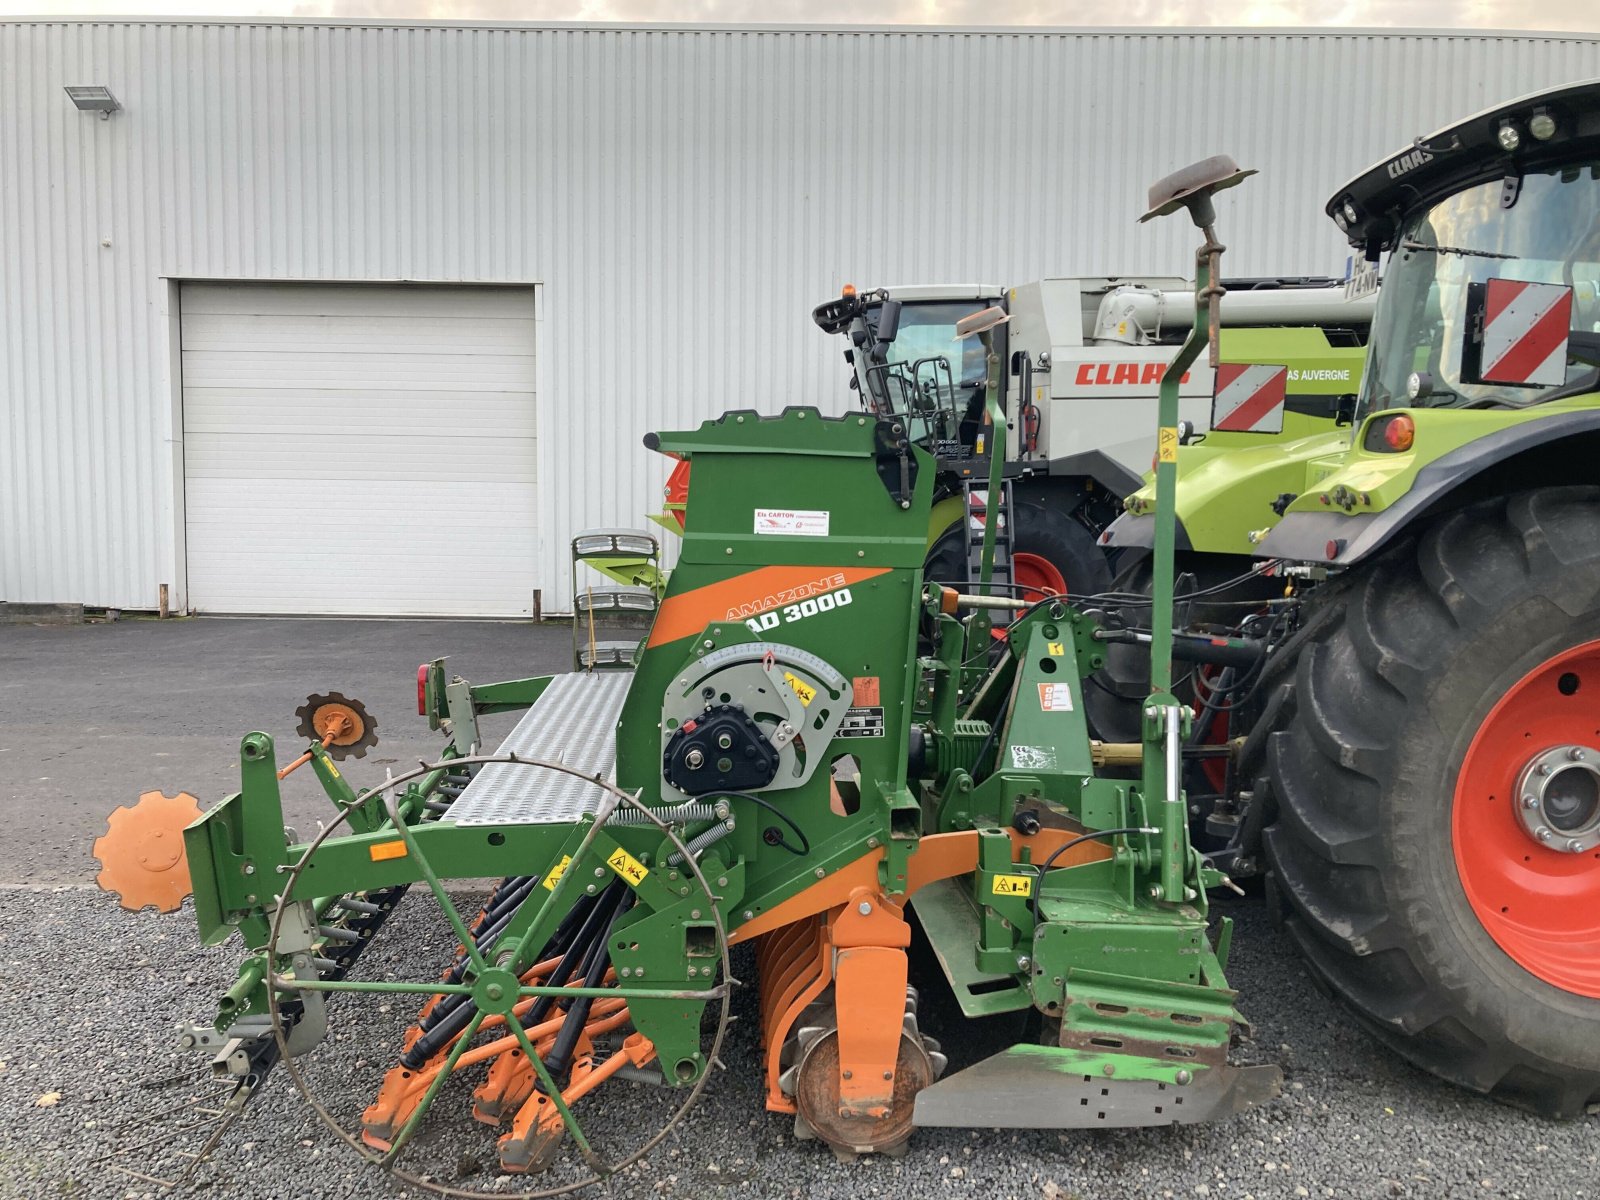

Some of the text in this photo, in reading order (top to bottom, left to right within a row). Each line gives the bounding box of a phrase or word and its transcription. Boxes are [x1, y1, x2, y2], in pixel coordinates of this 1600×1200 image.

[1387, 144, 1434, 179] CLAAS
[1075, 363, 1191, 385] CLAA
[1286, 369, 1350, 381] AS AUVERGNE
[726, 572, 846, 622] AMAZONE
[783, 588, 853, 623] 3000
